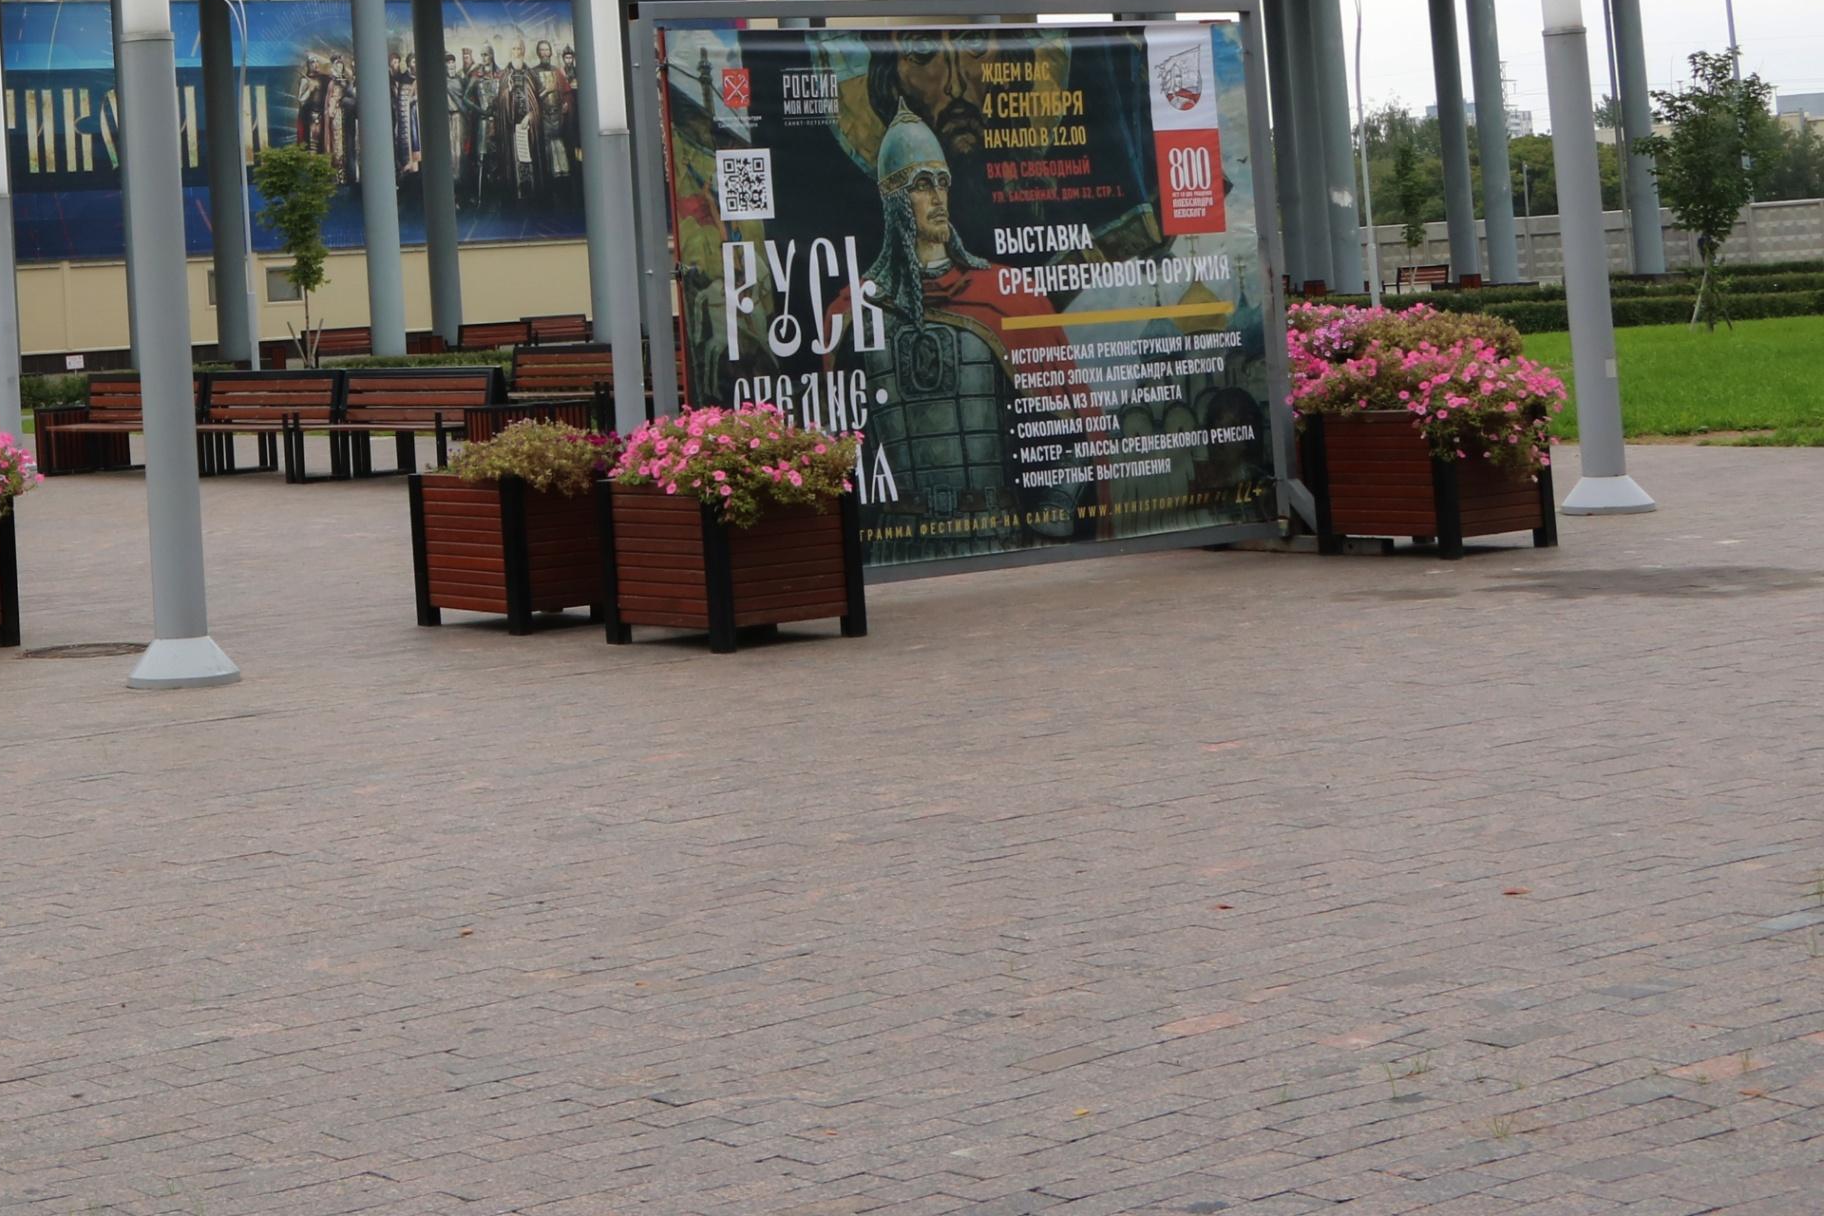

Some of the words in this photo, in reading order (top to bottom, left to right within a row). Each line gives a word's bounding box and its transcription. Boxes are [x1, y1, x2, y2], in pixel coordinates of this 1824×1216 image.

[782, 74, 839, 98] РОССИЯ
[981, 62, 1021, 84] ЖДЕМ
[1024, 61, 1050, 81] ВАС
[783, 99, 802, 115] МОЯ
[803, 98, 840, 114] ИСТОРИЯ
[982, 93, 992, 118] 4
[997, 90, 1084, 118] СЕНТЯБРЯ
[984, 127, 1036, 149] НАЧАЛО
[1040, 127, 1049, 146] В
[1053, 125, 1087, 146] 12.00
[986, 160, 1018, 180] ВХОД
[1020, 155, 1091, 178] СВОБОДНЫЙ
[1168, 146, 1211, 191] 800
[994, 223, 1093, 255] ВЫСТАВКА
[998, 259, 1157, 296] СРЕДНЕВЕКОВОГО
[1161, 255, 1231, 284] ОРУЖИЯ
[722, 235, 886, 361] РУСЬ
[1011, 344, 1095, 365] ИСТОРИЧЕСКАЯ
[1097, 336, 1182, 358] РЕКОНСТРУКЦИЯ
[1184, 335, 1192, 351] И
[1193, 331, 1243, 351] ВОИНСКОЕ
[1014, 371, 1065, 389] РЕМЕСЛО
[1067, 368, 1104, 385] ЭПОХИ
[1106, 361, 1174, 382] АЛЕКСАНДРА
[1175, 357, 1224, 375] НЕВСКОГО
[1014, 396, 1071, 414] СТРЕЛЬБА
[1073, 394, 1088, 410] ИЗ
[1090, 391, 1119, 408] ЛУКА
[1121, 390, 1128, 405] И
[1130, 384, 1183, 405] АРБАЛЕТА
[1017, 417, 1083, 439] СОКОЛИНАЯ
[1085, 415, 1120, 432] ОХОТА
[1020, 444, 1063, 463] МАСТЕР
[1074, 439, 1119, 458] КЛАССЫ
[1121, 430, 1208, 454] СРЕДНЕВЕКОВОГО
[1210, 425, 1255, 444] РЕМЕСЛА
[1022, 466, 1094, 488] КОНЦЕРТНЫЕ
[1096, 457, 1172, 481] ВЫСТУПЛЕНИЯ
[1235, 481, 1265, 504] 12+
[859, 524, 913, 543] ГРАММА
[919, 515, 997, 536] ФЕСТИВАЛЯ
[1004, 512, 1020, 528] НА
[1026, 507, 1070, 525] САЙТЕ:
[1076, 490, 1227, 519] WWW.MYHISTORYPARKRU
